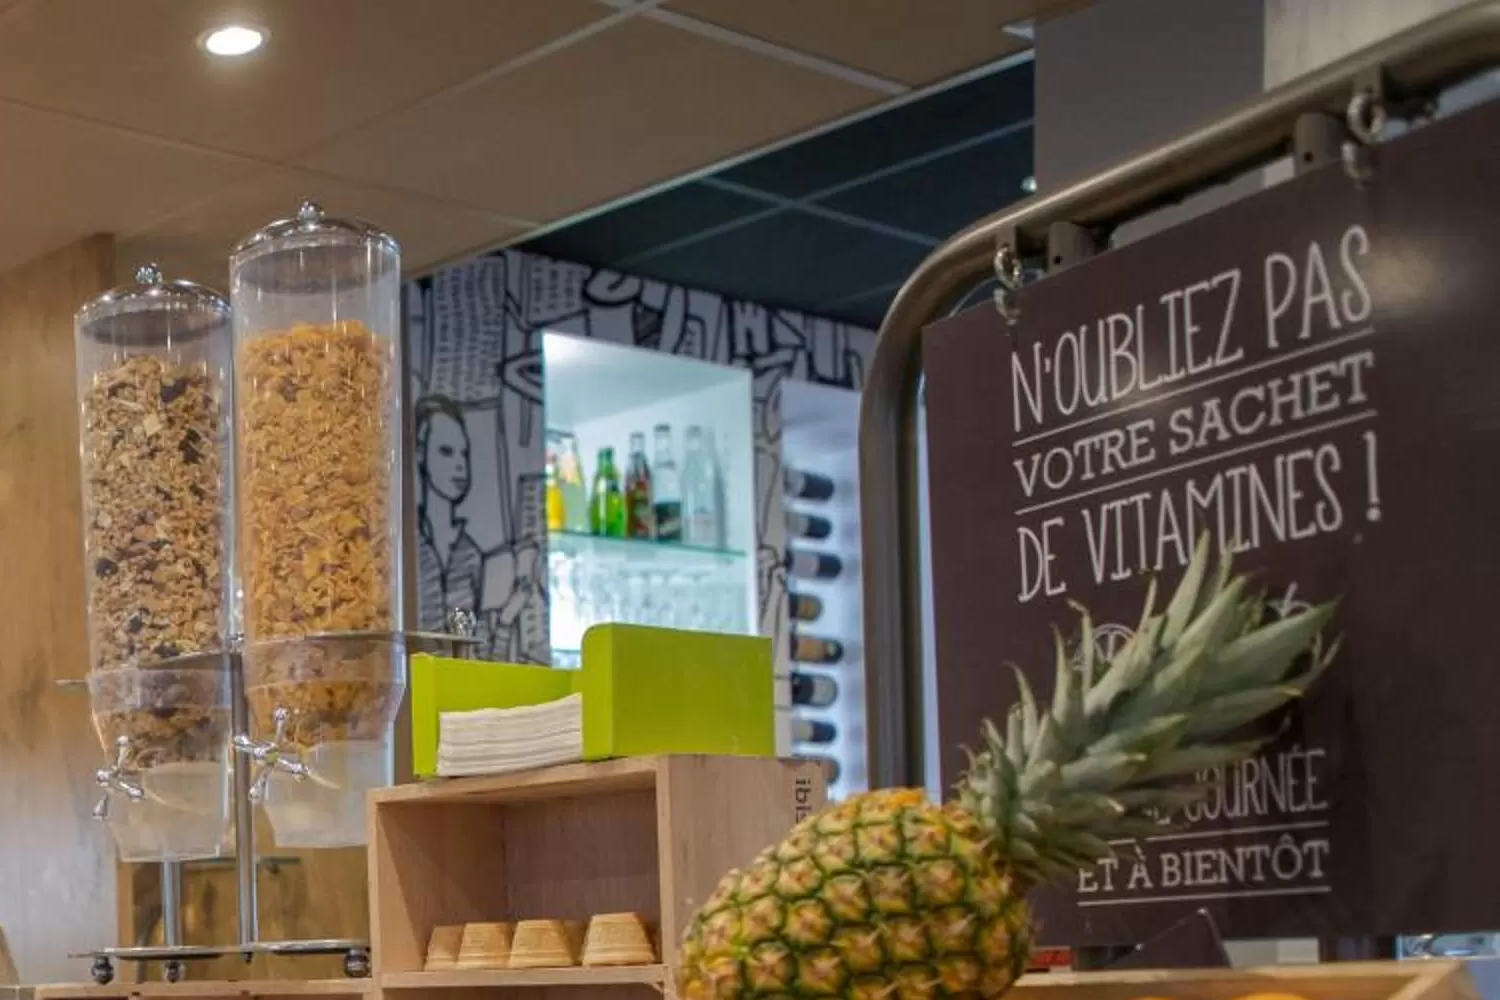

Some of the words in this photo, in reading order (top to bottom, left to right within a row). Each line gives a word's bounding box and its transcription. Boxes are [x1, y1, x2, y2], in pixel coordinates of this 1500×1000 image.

[1010, 267, 1246, 433] N'OUBLIEZ
[1264, 224, 1373, 349] PAS
[1012, 417, 1157, 498] VOTRE
[1167, 350, 1375, 456] SACHET
[1016, 516, 1067, 603] DE
[1082, 443, 1344, 585] VITAMINES
[1075, 857, 1119, 893] ET
[1126, 843, 1155, 890] À
[1160, 832, 1330, 887] BIENTÔT
